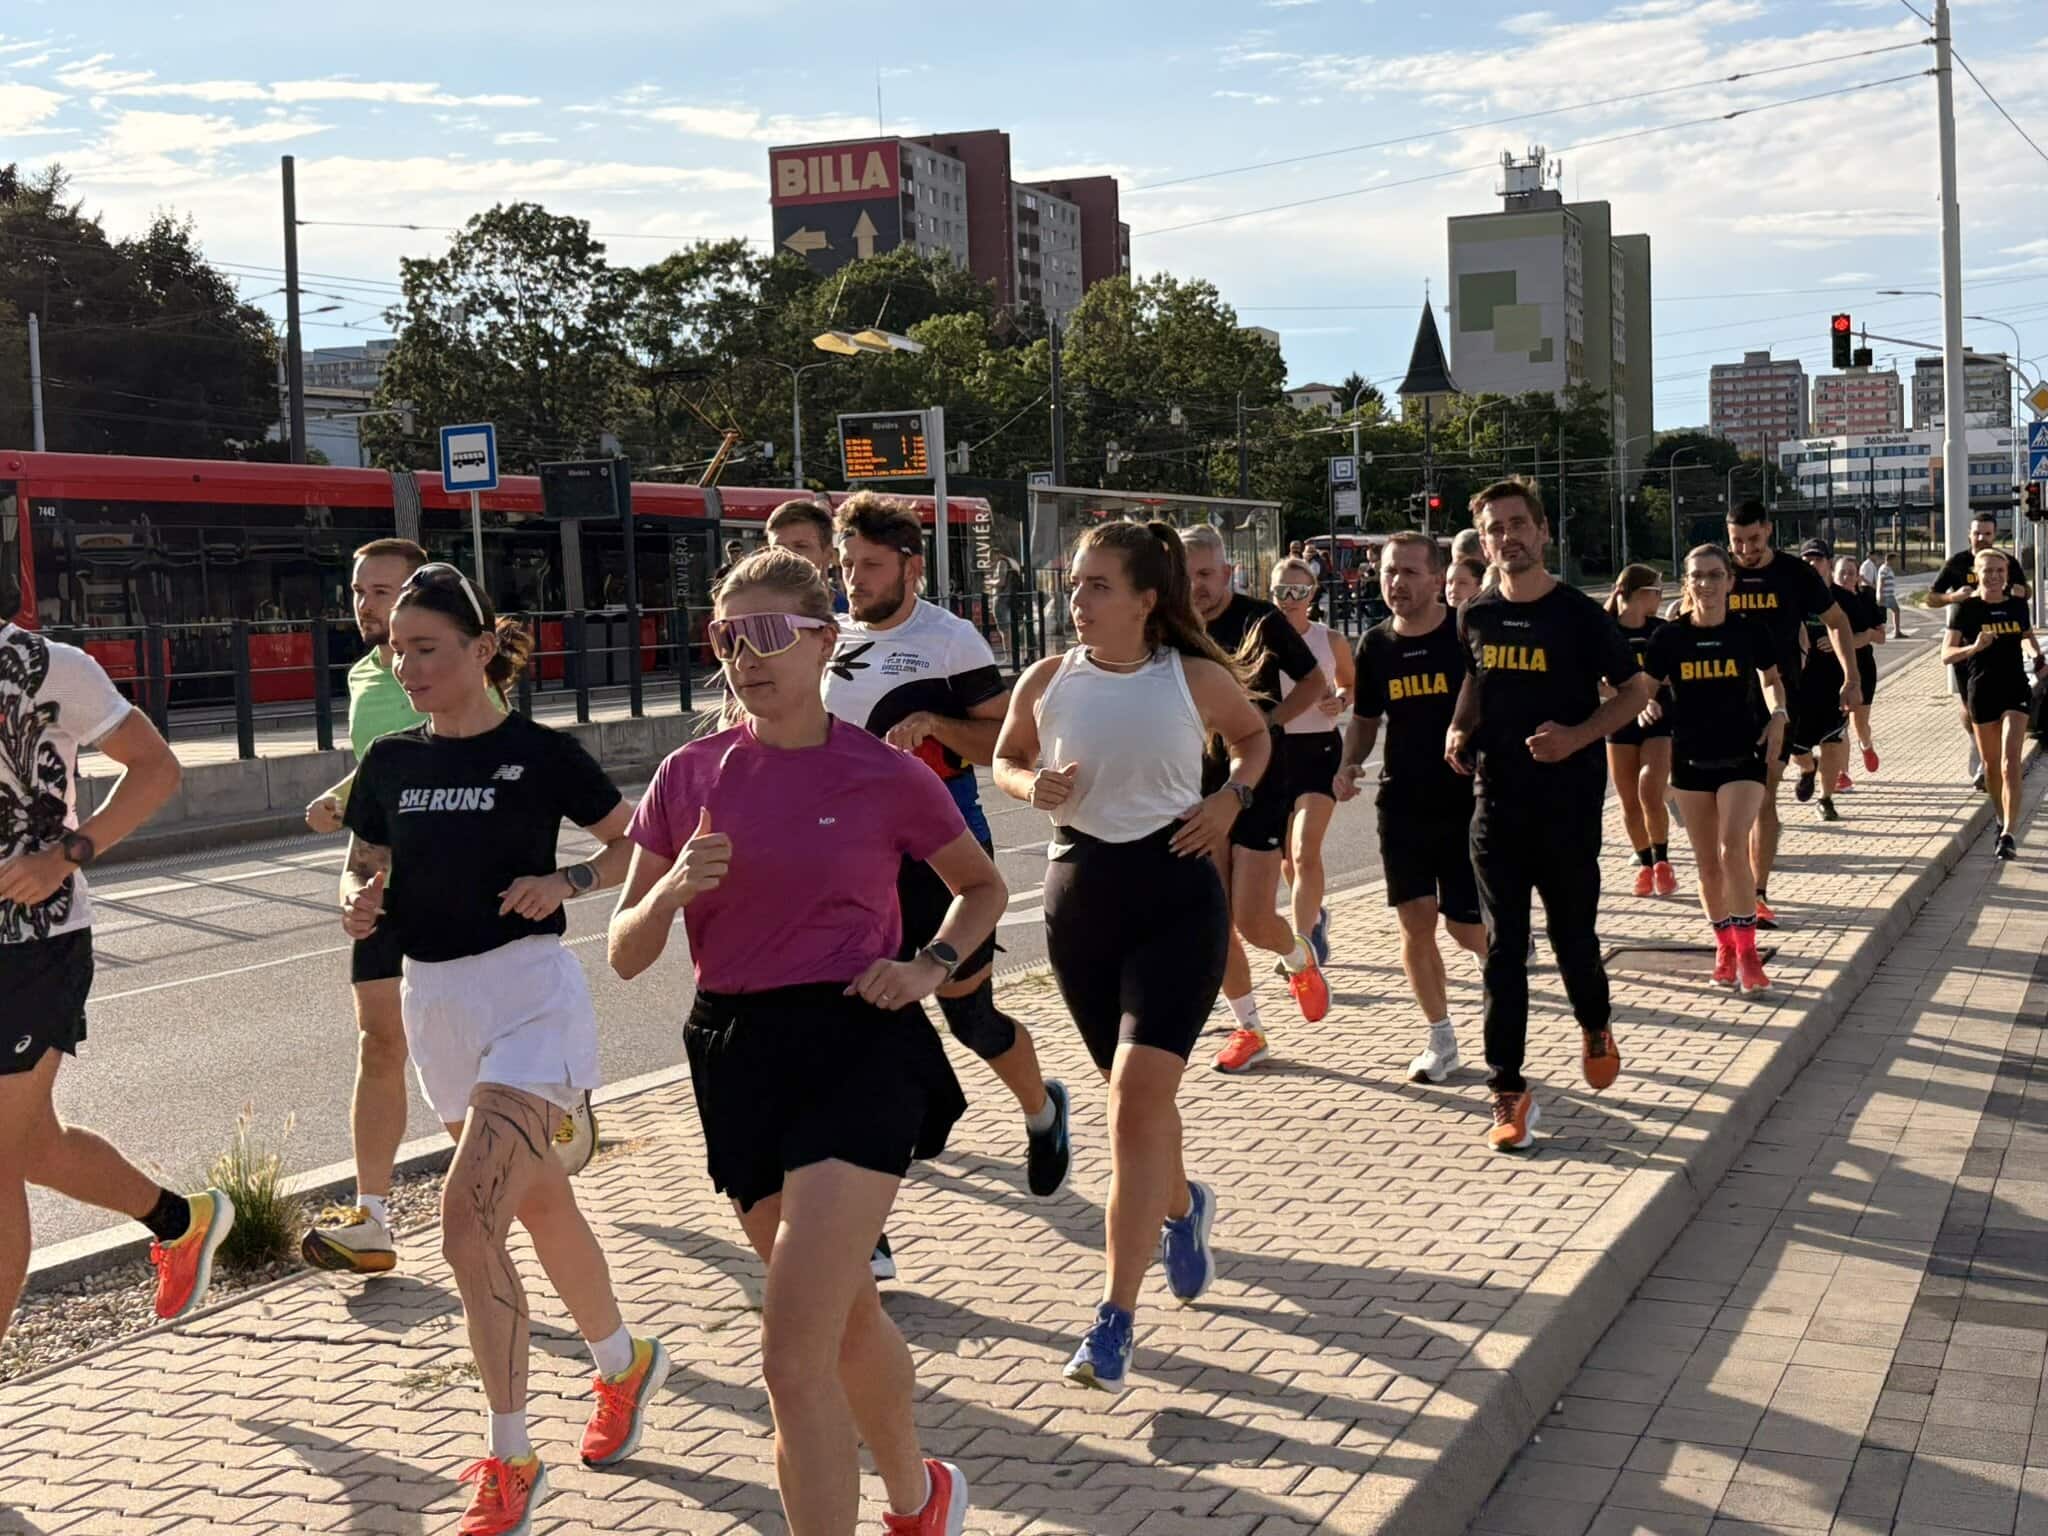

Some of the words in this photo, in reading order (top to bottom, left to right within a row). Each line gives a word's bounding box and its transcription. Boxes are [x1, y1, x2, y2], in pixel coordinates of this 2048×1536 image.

[777, 151, 890, 197] BILLA
[1729, 593, 1778, 610] BILLA
[1482, 644, 1547, 672] BILLA
[1680, 659, 1739, 681] BILLA
[1388, 672, 1448, 700] BILLA
